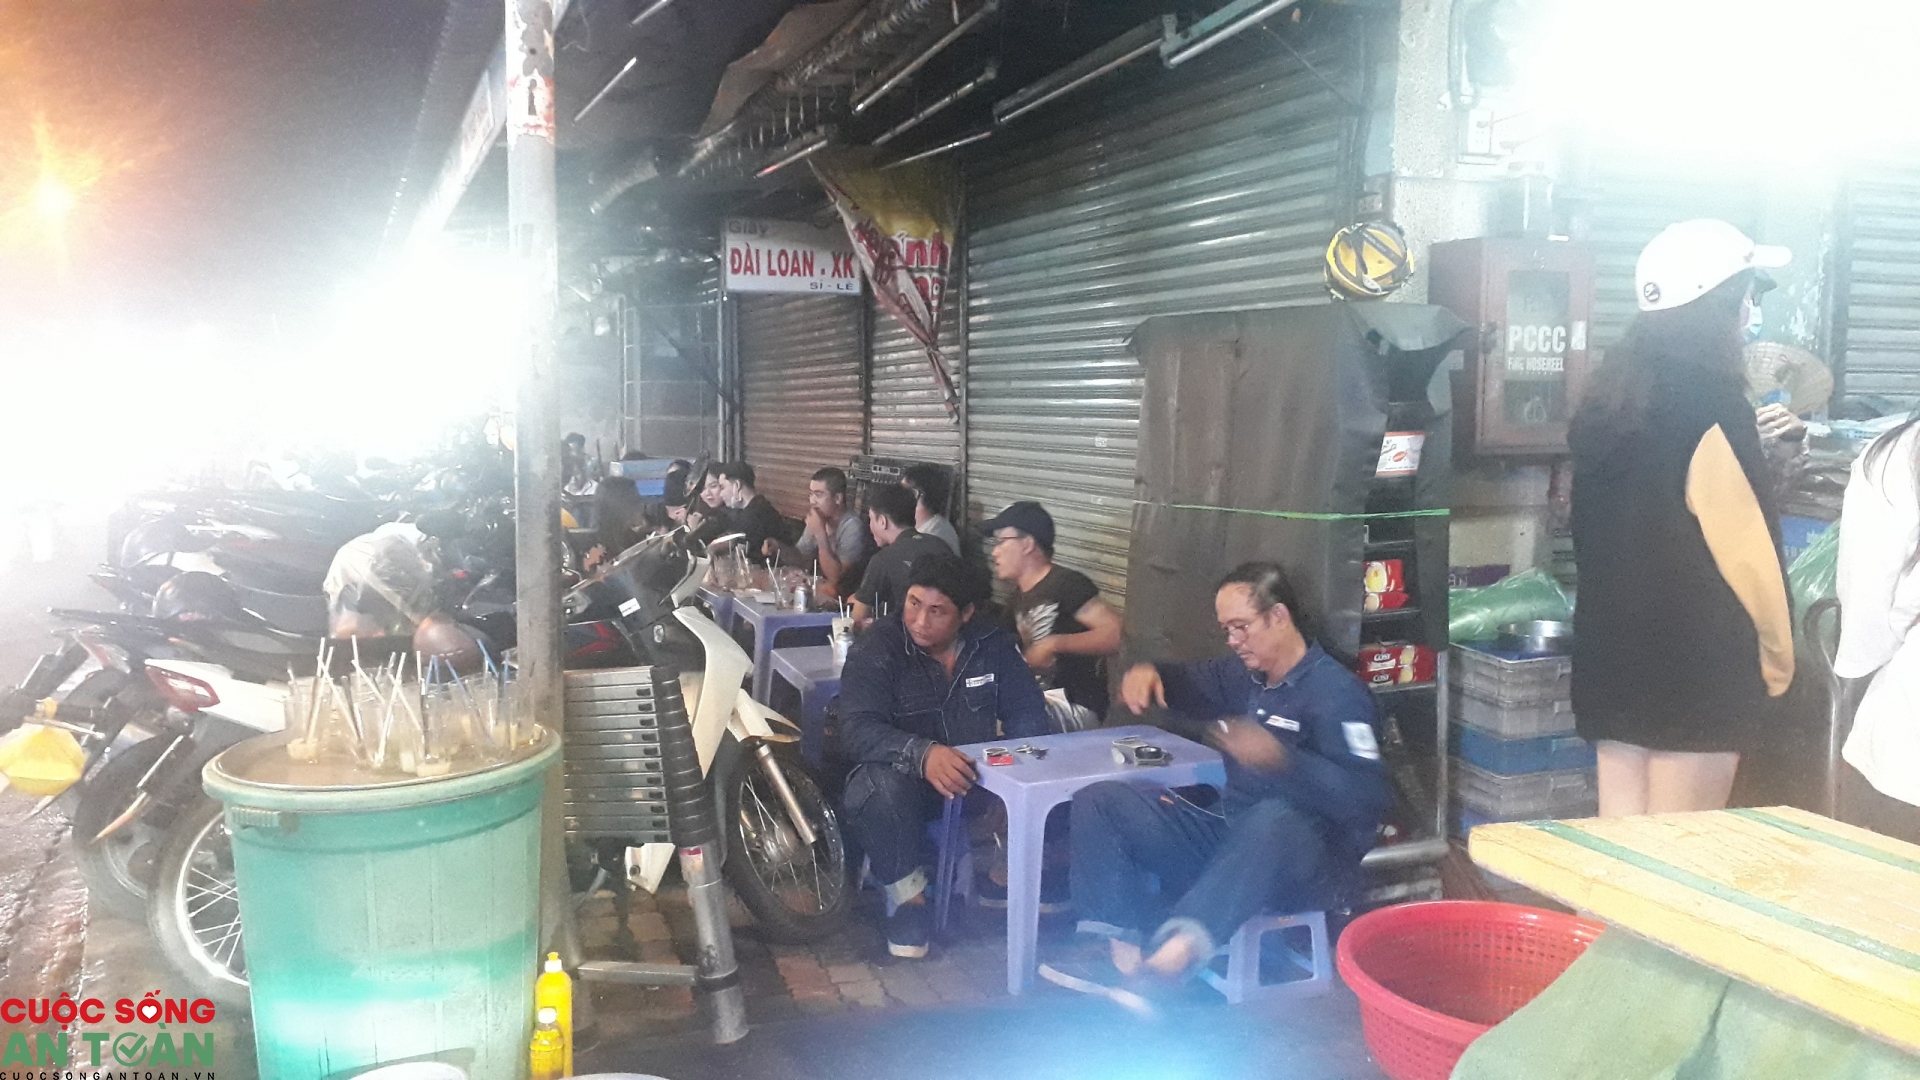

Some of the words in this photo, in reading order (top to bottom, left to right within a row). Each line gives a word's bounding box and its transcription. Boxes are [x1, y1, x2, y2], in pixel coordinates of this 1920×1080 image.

[730, 242, 760, 276] ĐÀI
[767, 248, 814, 277] LOAN
[831, 250, 855, 279] XK
[1508, 324, 1567, 353] PCCC
[1526, 357, 1564, 371] HOSEREEL
